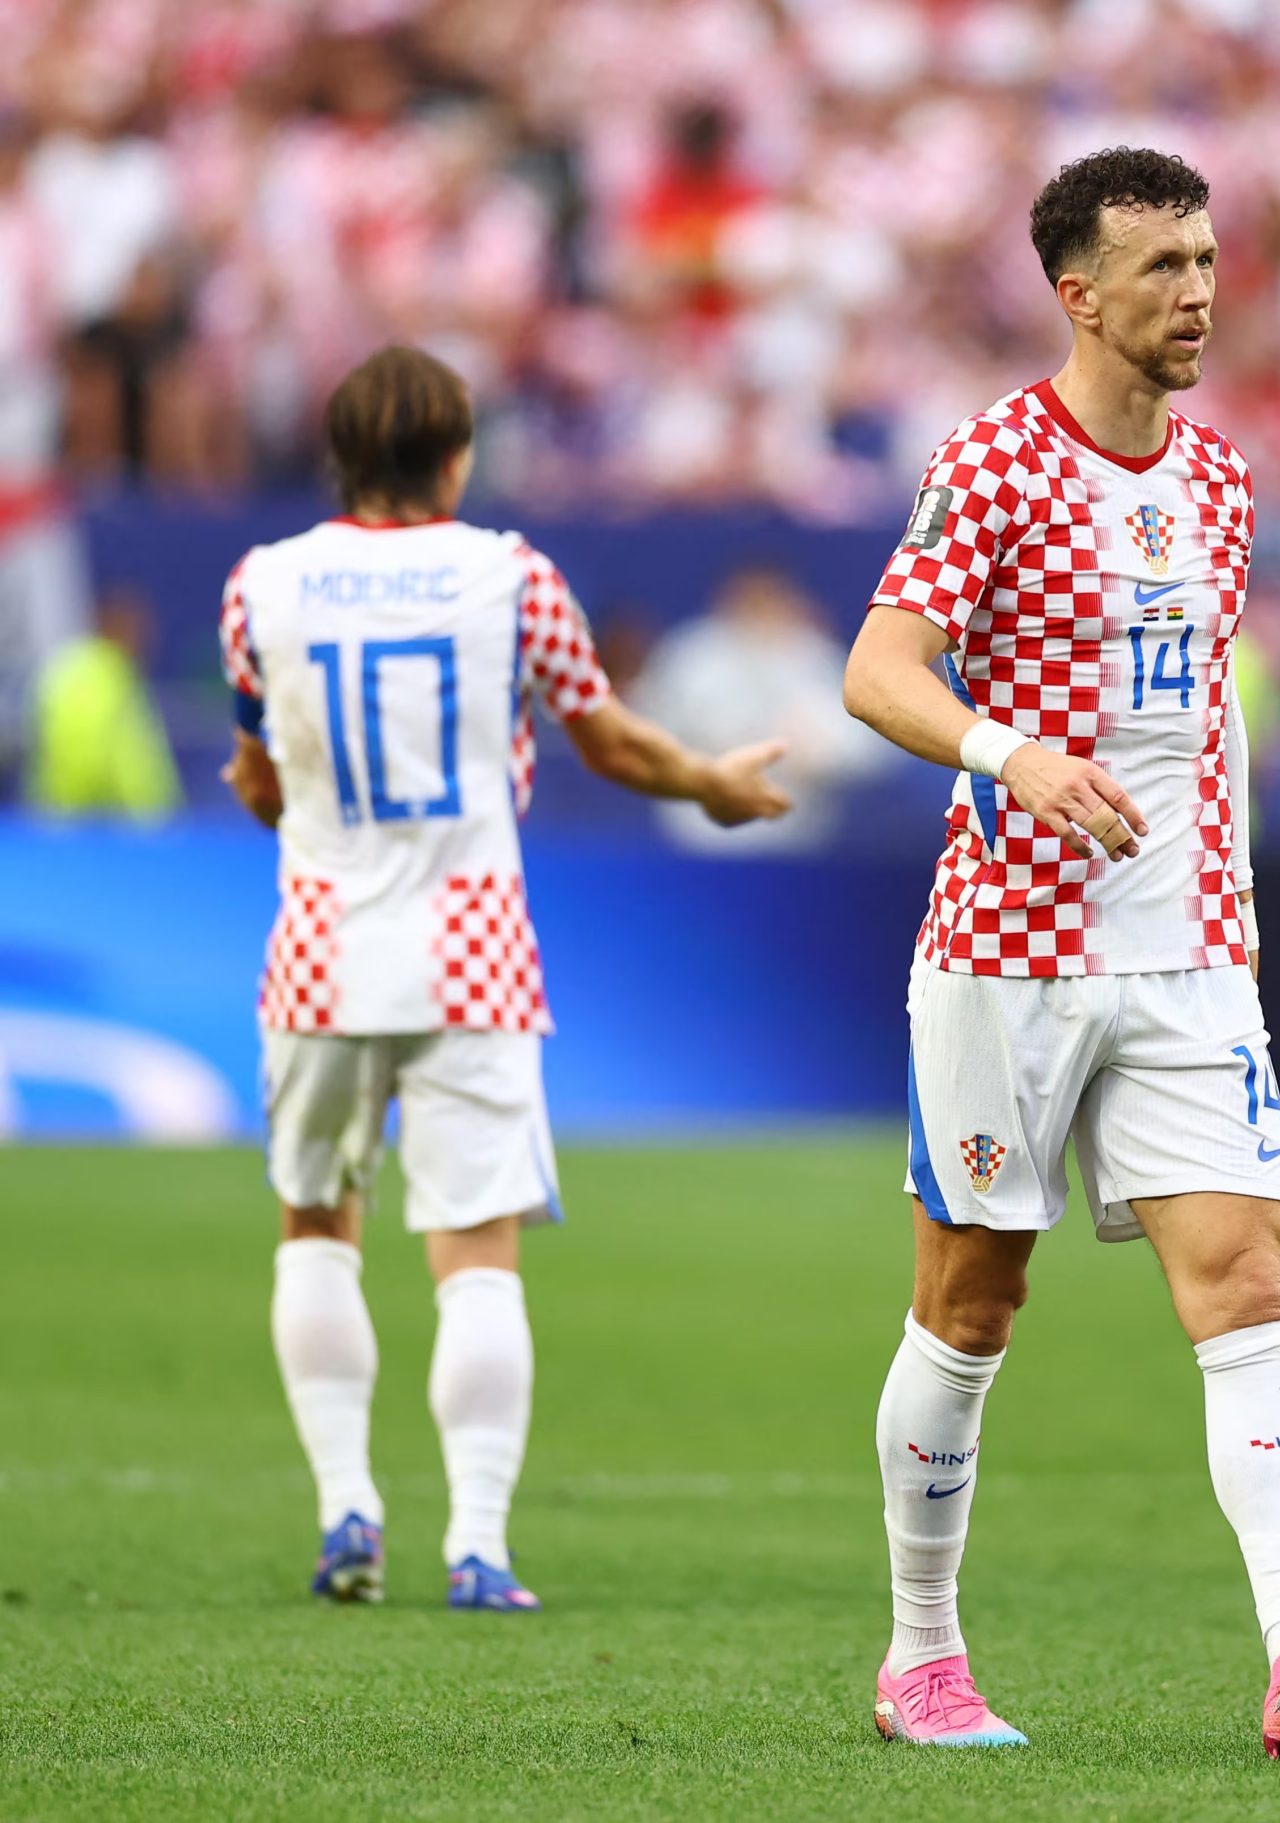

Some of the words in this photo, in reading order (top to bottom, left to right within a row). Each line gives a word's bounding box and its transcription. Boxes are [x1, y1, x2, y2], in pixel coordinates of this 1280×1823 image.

[1144, 510, 1157, 549] HNS
[1127, 624, 1195, 710] 14
[308, 636, 461, 827] 10
